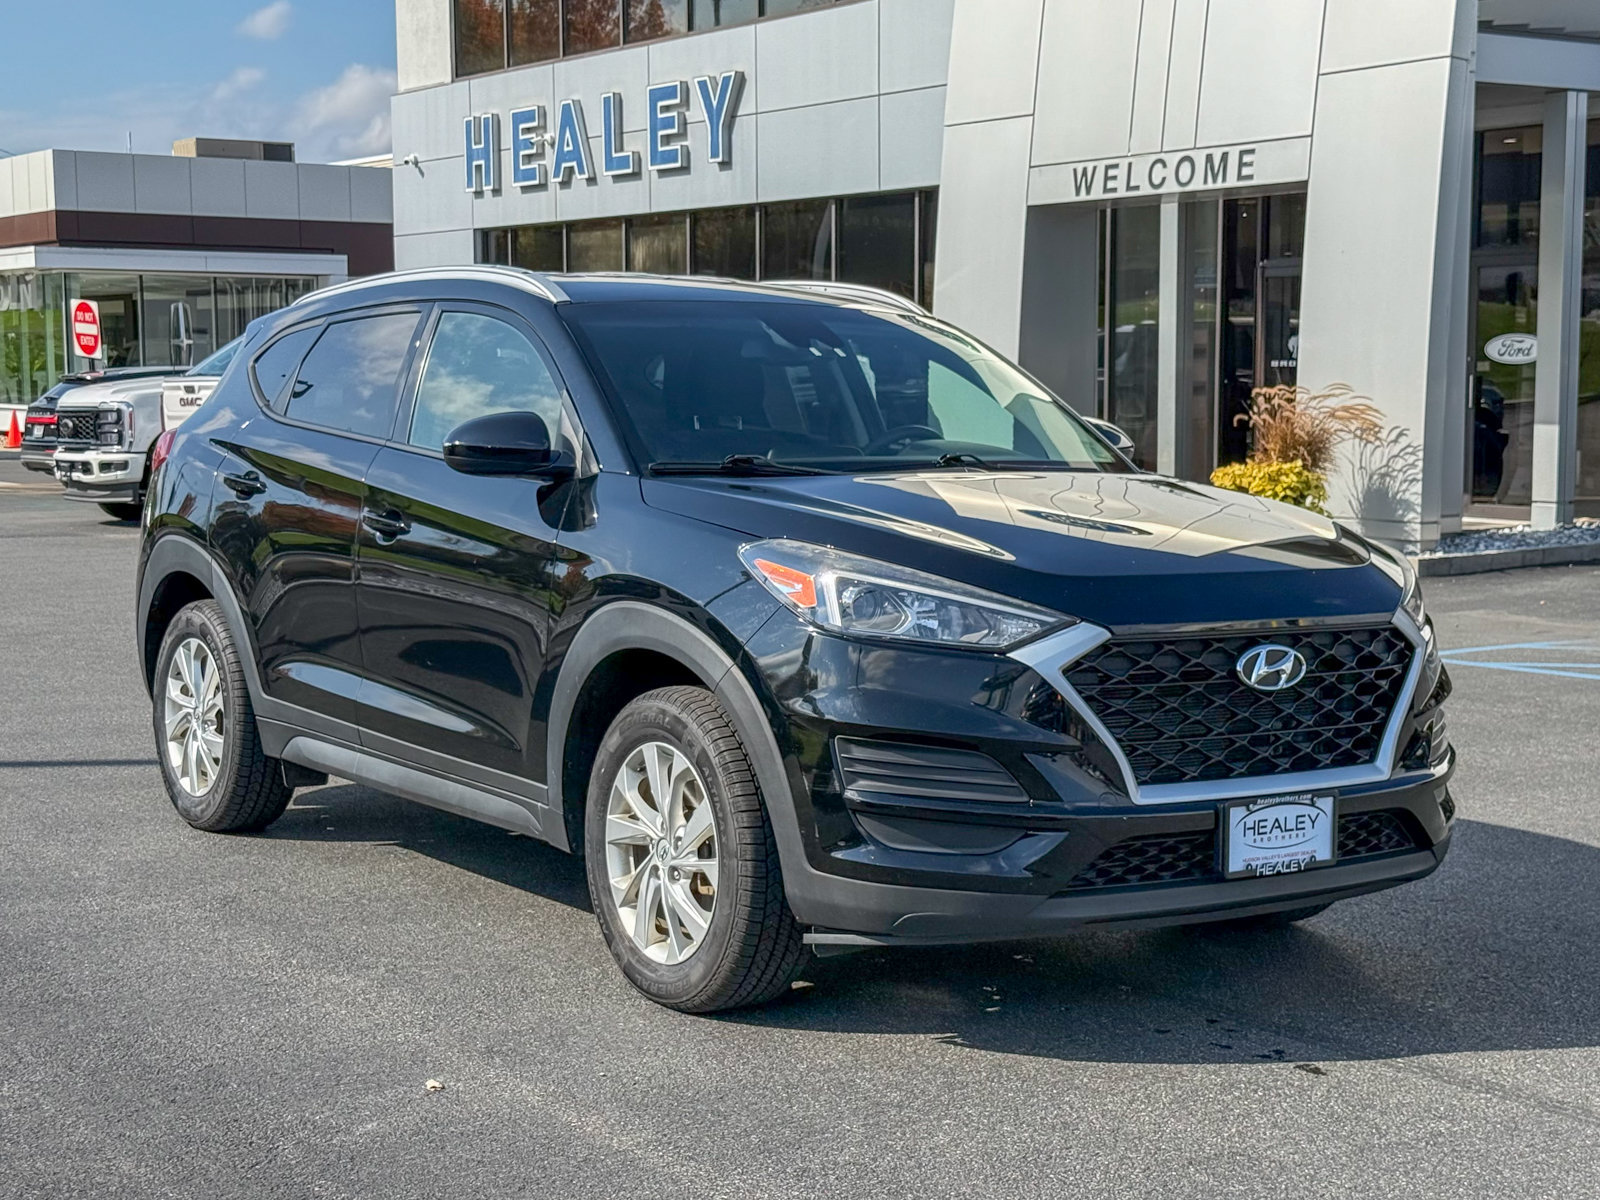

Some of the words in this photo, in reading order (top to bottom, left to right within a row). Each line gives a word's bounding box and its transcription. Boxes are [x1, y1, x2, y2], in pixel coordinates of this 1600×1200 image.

[464, 70, 744, 192] HEALEY
[1073, 148, 1256, 197] WELCOME
[76, 311, 84, 321] DO
[85, 312, 94, 323] NOT
[80, 335, 95, 346] ENTER
[1497, 339, 1534, 357] Ford
[179, 397, 202, 406] GMC
[1243, 812, 1320, 838] HEALEY
[1256, 857, 1307, 877] HEALEY
